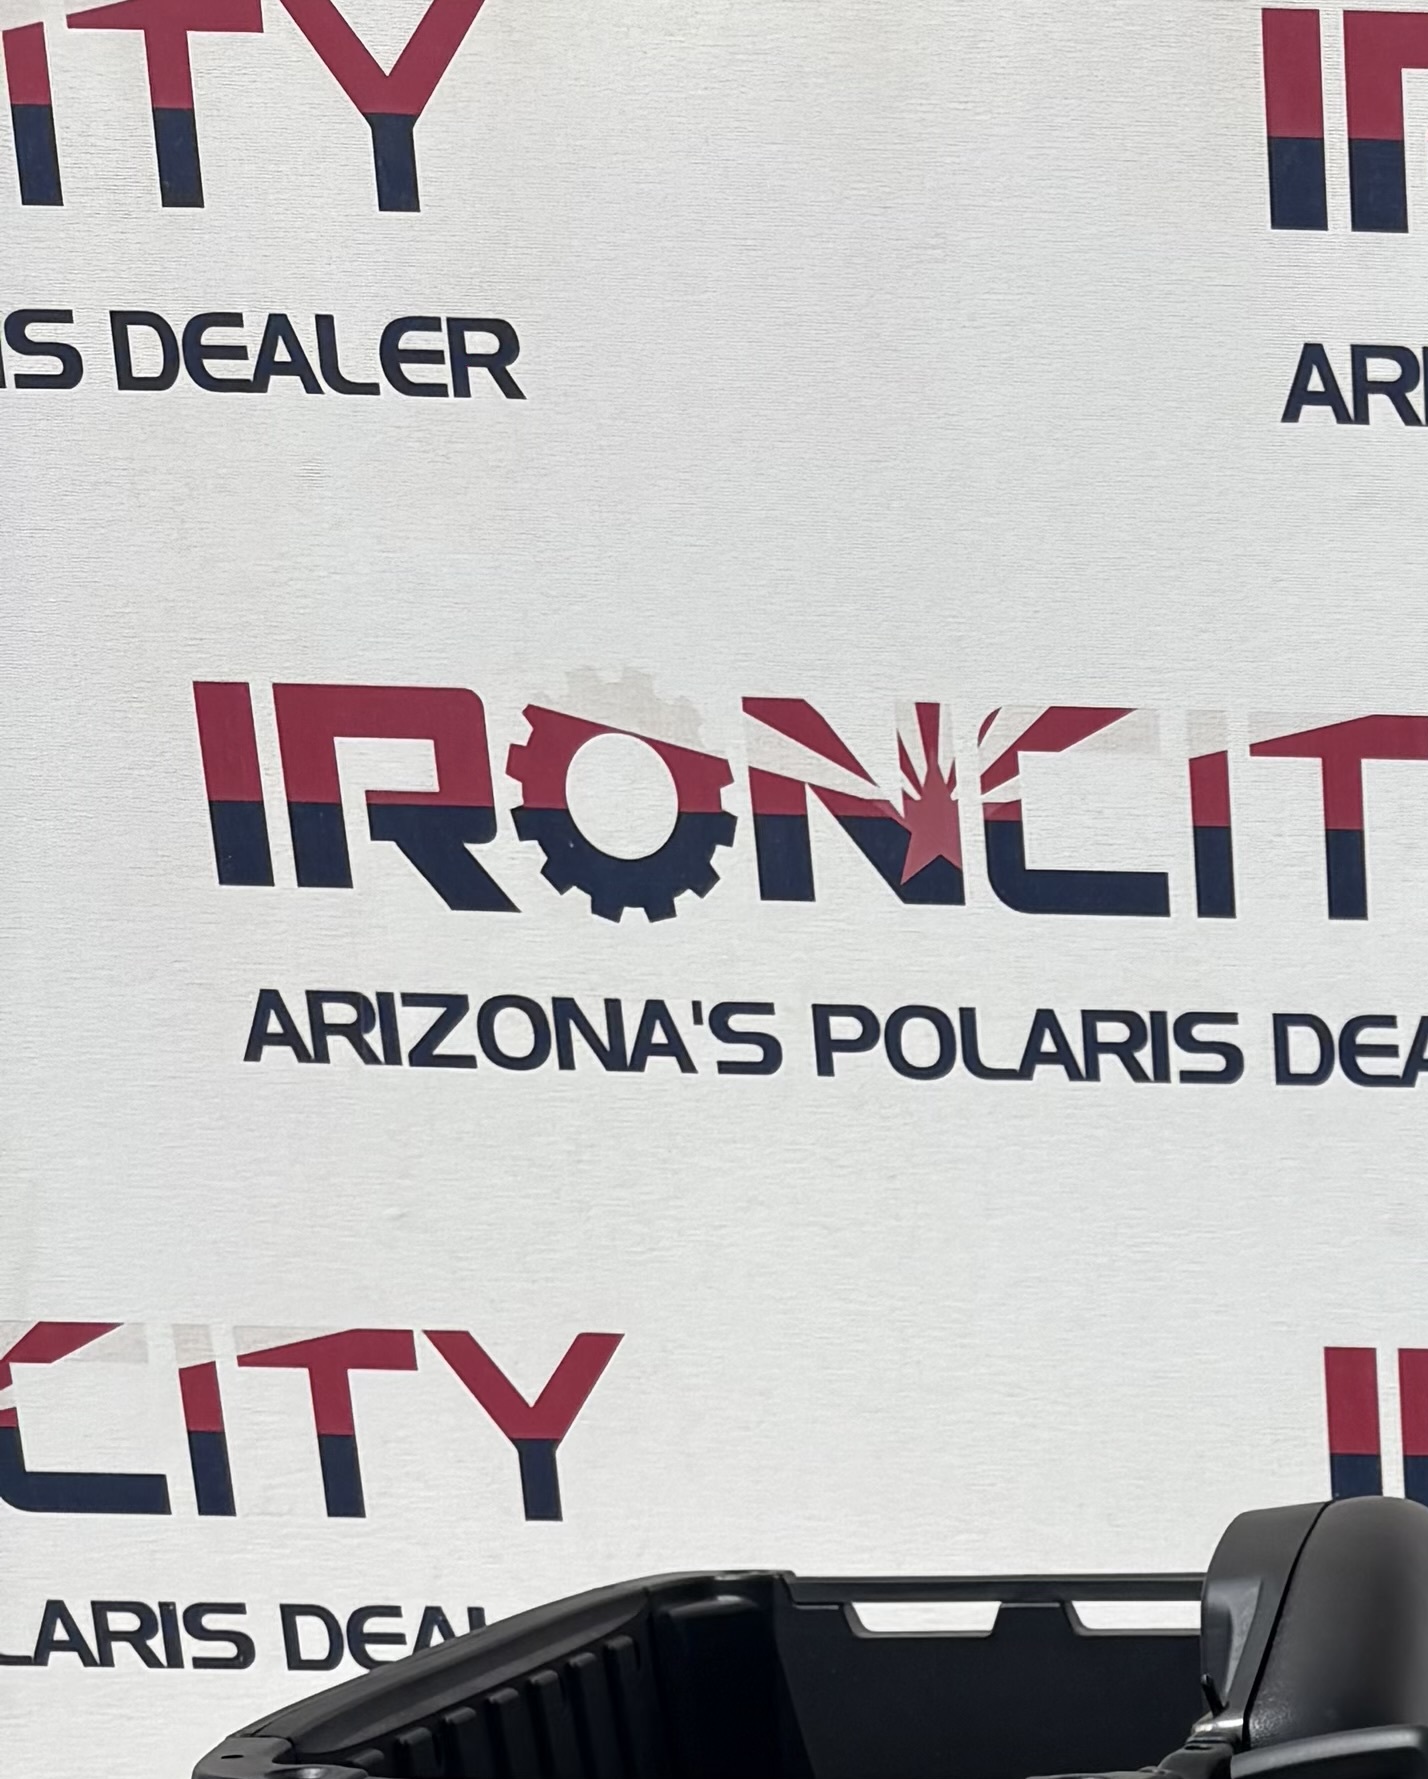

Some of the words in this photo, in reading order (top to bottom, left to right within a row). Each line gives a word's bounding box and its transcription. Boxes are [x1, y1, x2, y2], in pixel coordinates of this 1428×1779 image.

[109, 310, 526, 399] DEALER
[244, 989, 782, 1075] ARIZONA'S
[812, 1004, 1244, 1084] POLARIS
